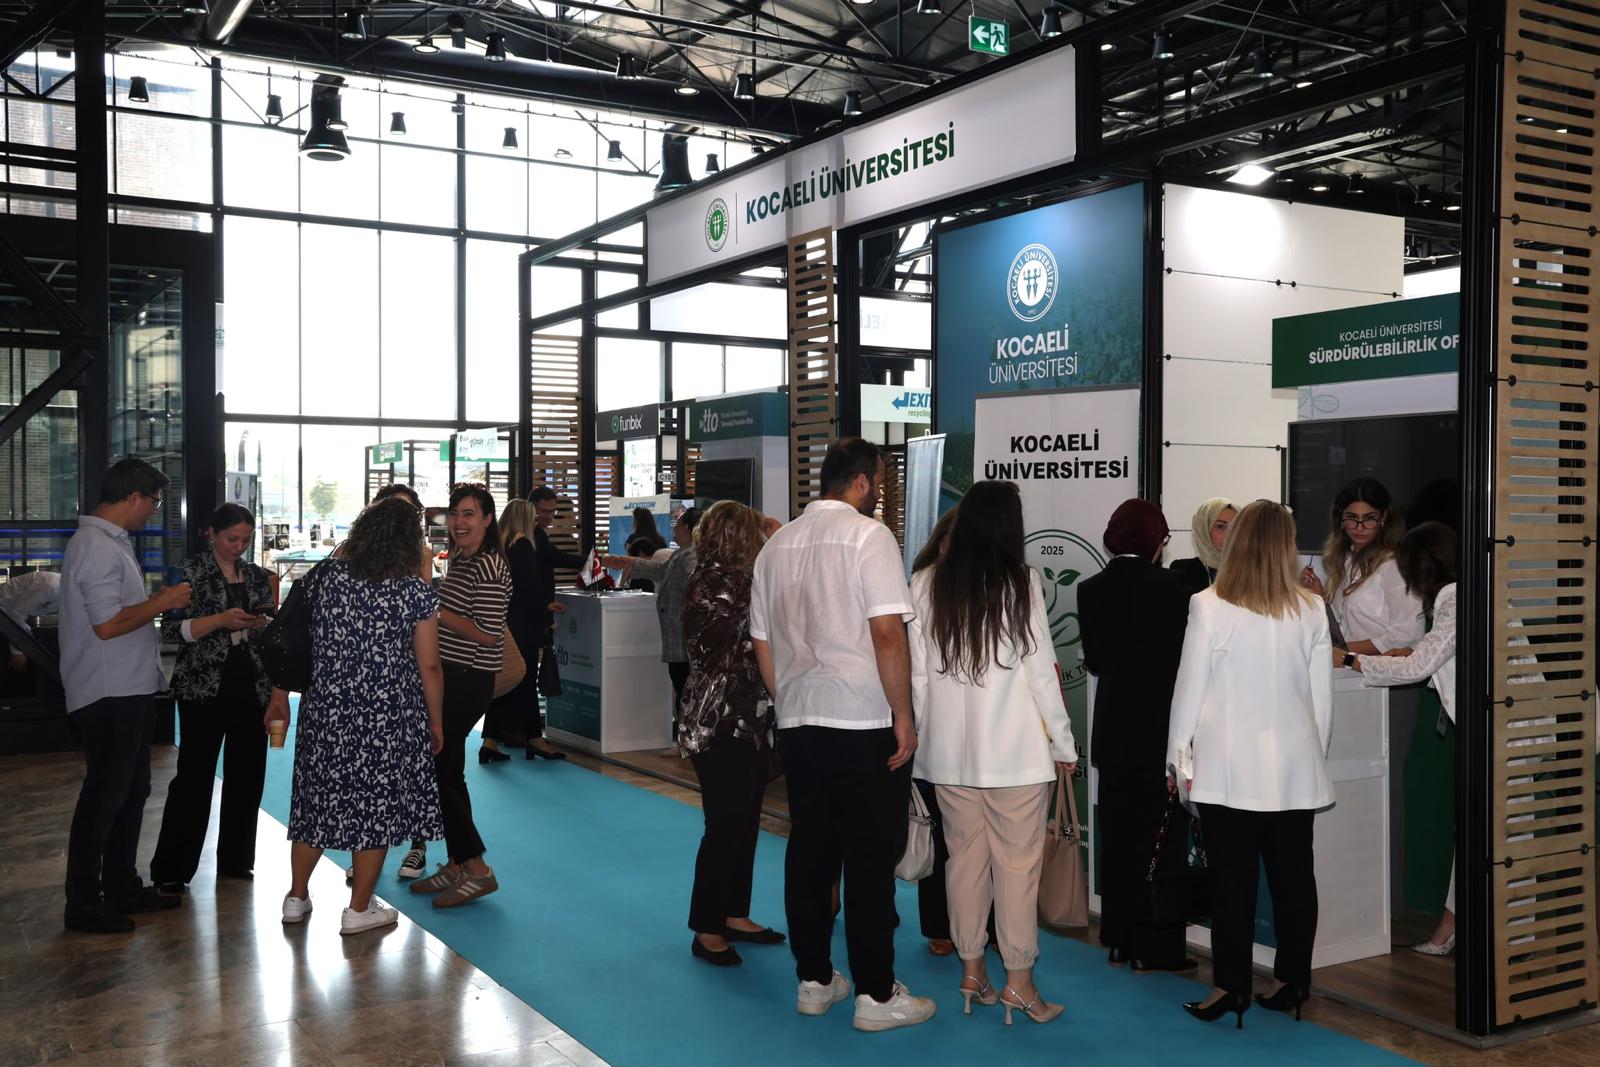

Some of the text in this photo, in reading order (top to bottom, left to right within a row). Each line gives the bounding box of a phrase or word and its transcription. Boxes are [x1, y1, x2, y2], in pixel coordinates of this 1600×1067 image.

[746, 121, 955, 225] KOCAELİ ÜNİVERSİTESİ
[997, 323, 1070, 360] KOCAELİ
[1339, 317, 1443, 343] KOCAELİ ÜNİVERSİTESİ
[1308, 334, 1460, 365] SÜRDÜRÜLEBİLİRLİK OF
[989, 352, 1079, 384] ÜNİVERSİTESİ
[619, 414, 643, 432] funbix
[1010, 428, 1100, 453] KOCAELİ
[984, 456, 1129, 480] ÜNİVERSİTESİ
[1041, 545, 1064, 555] 2025
